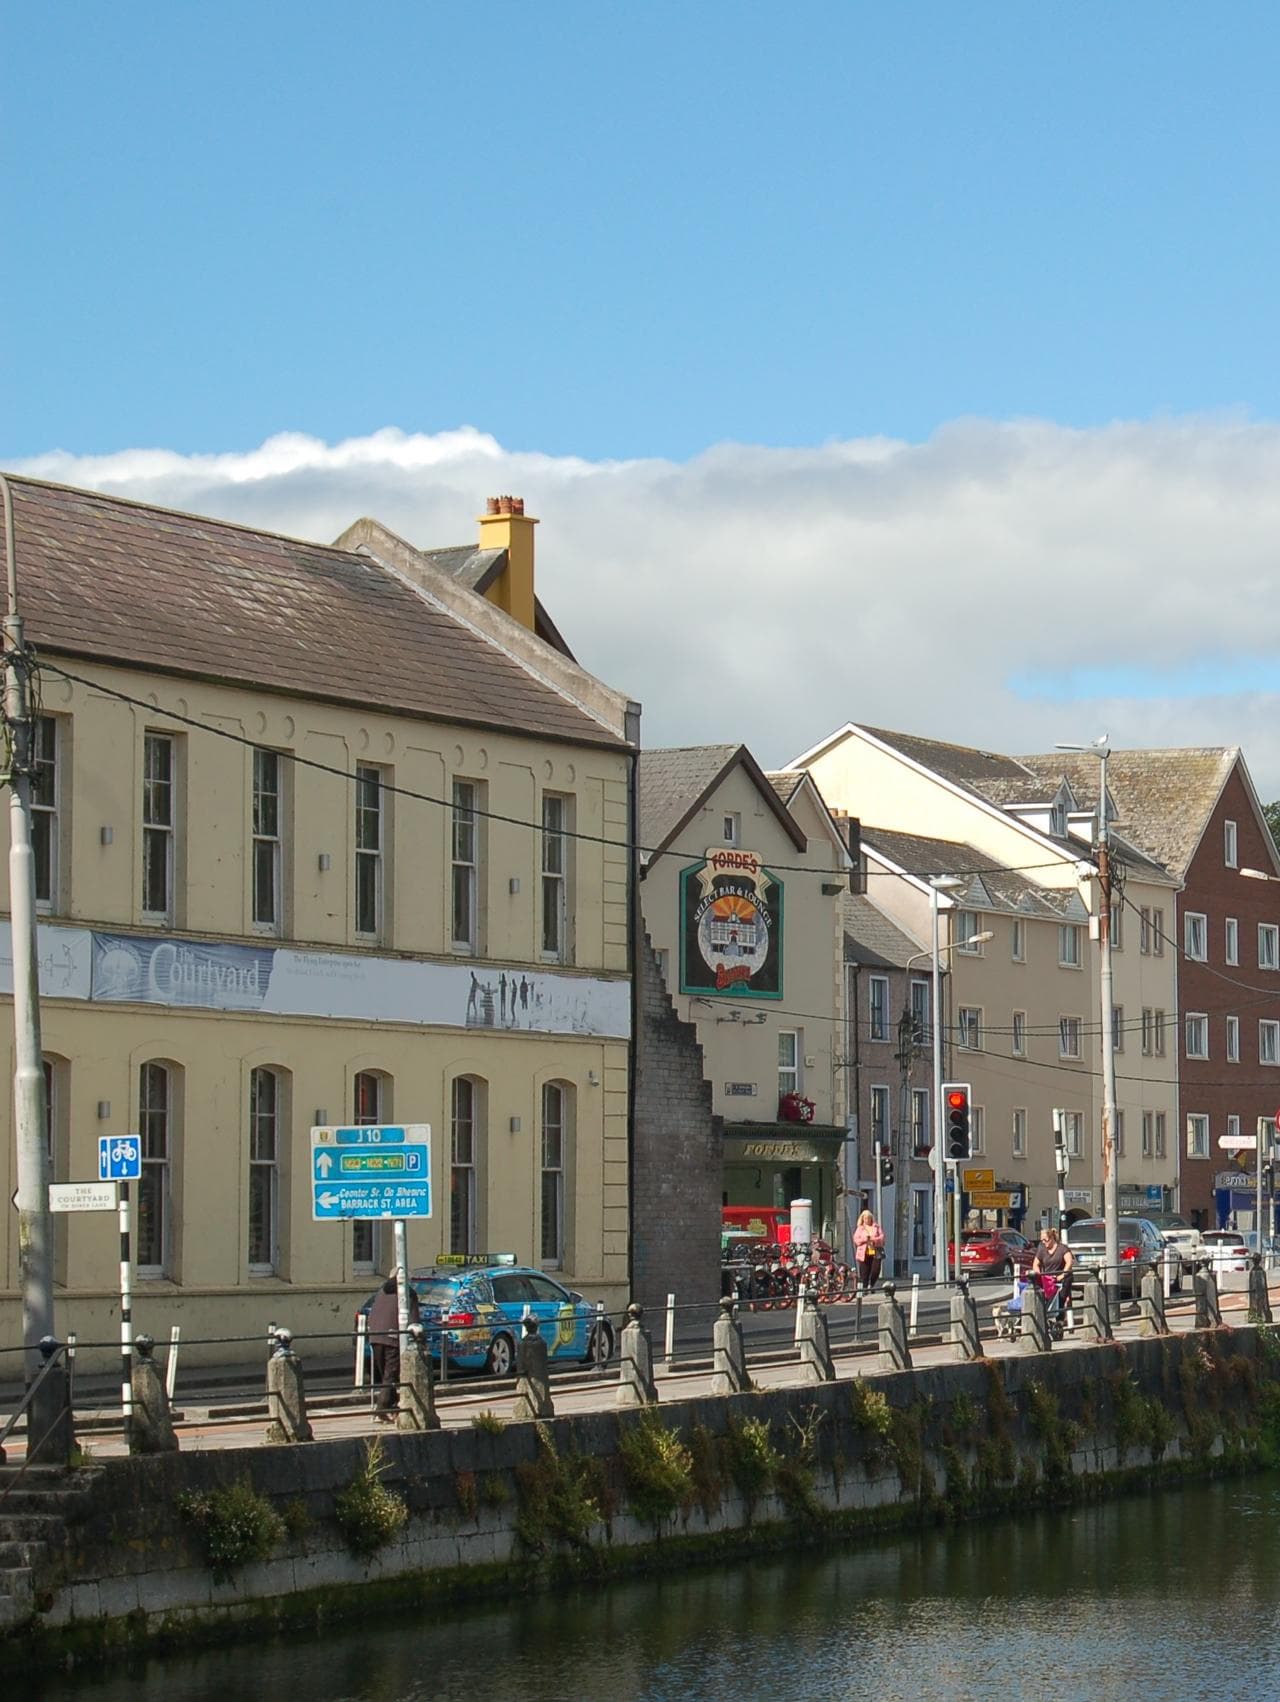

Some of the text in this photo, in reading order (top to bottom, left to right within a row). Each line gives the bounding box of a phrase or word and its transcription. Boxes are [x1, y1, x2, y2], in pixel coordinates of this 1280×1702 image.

[711, 852, 758, 875] FORDE'S
[693, 890, 718, 923] SELECT
[719, 885, 735, 897] BAR
[744, 888, 773, 928] LOUNGE
[149, 943, 260, 995] Courtyard
[409, 1155, 416, 1168] P
[57, 1195, 110, 1203] COURTYARD
[341, 1199, 378, 1209] BARRACK
[395, 1198, 417, 1208] AREA
[466, 1255, 488, 1264] TAXI
